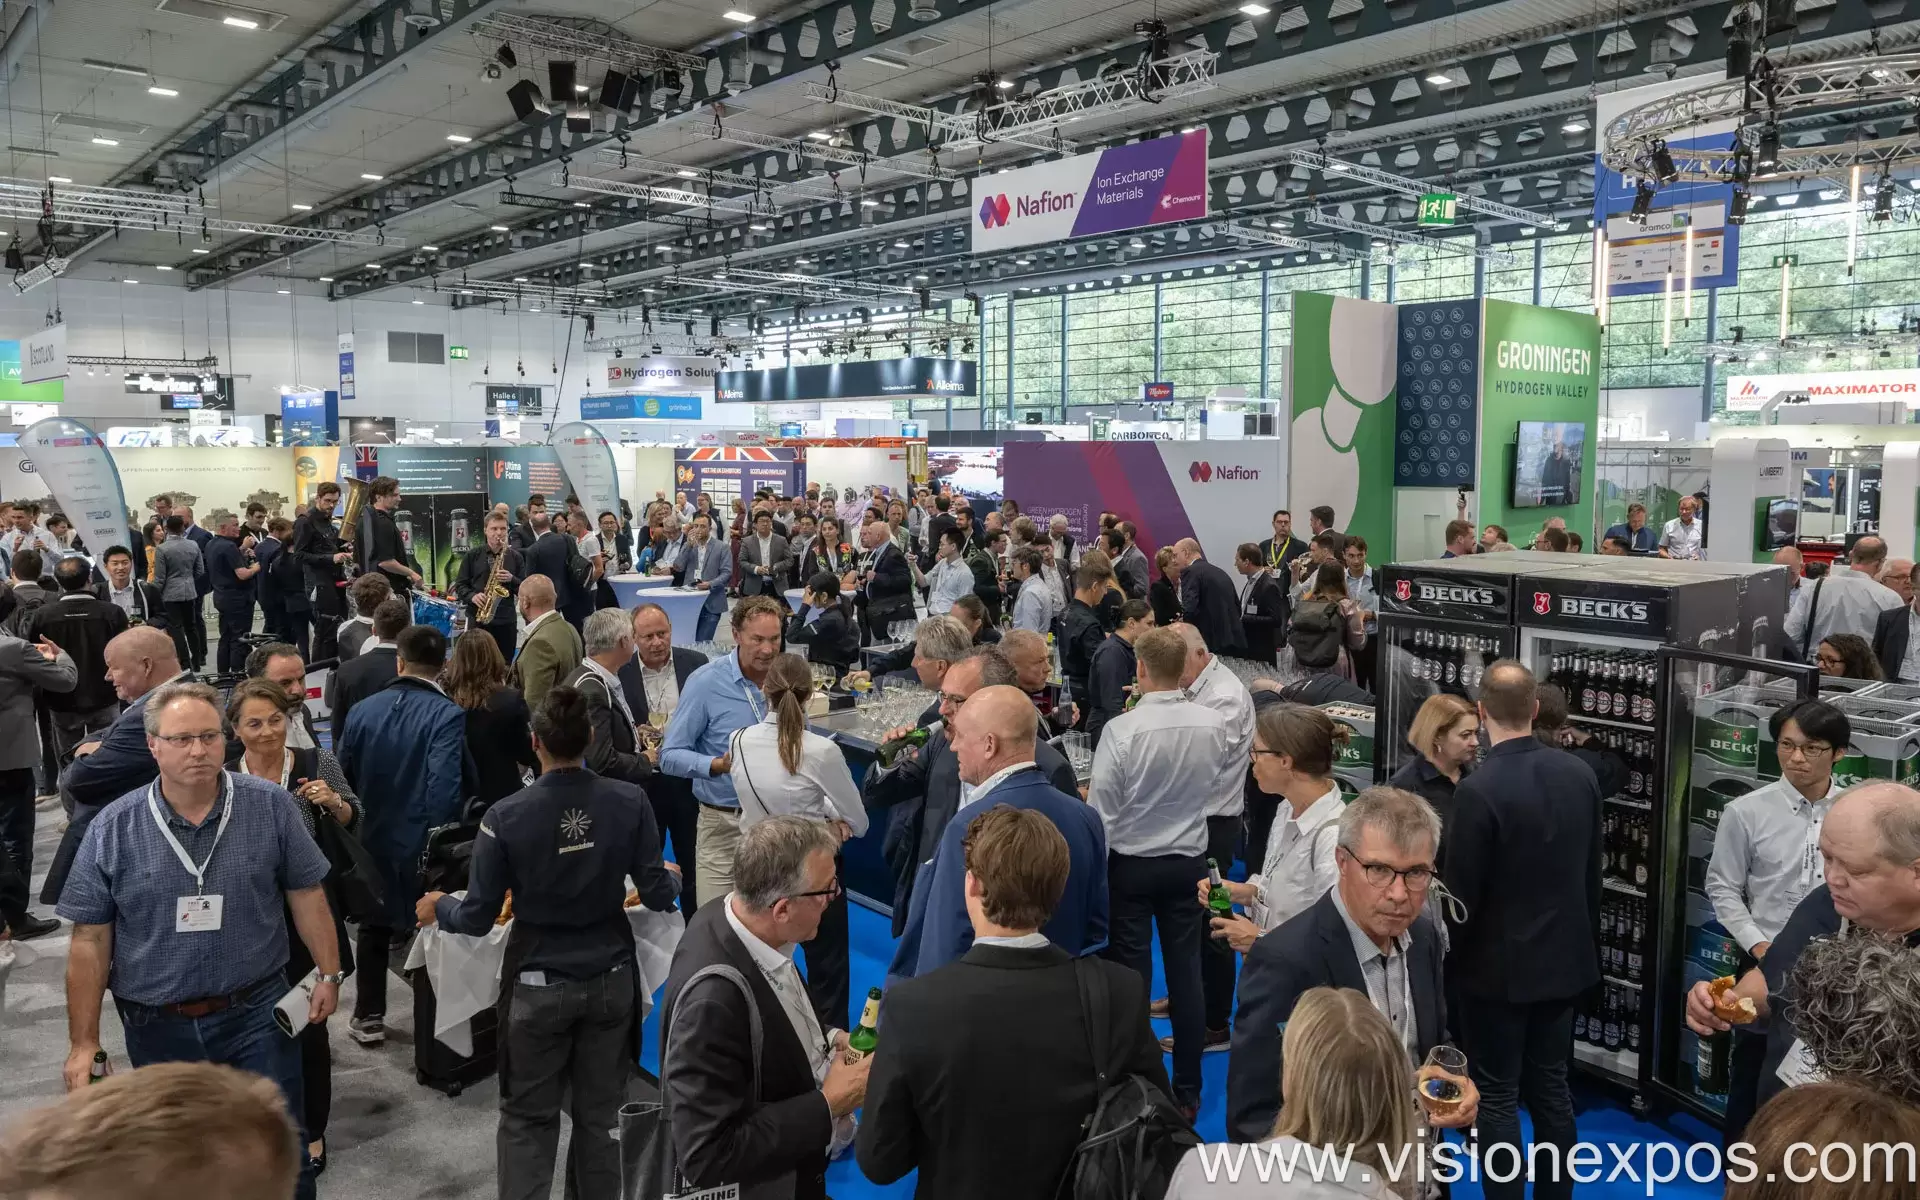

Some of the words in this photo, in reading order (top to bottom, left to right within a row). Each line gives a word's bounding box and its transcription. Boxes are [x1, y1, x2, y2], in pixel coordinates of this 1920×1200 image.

[1096, 175, 1112, 189] Ion
[1113, 166, 1165, 187] Exchange
[1096, 187, 1145, 205] Materials
[1171, 194, 1202, 205] Chemours
[1015, 190, 1075, 218] Nafion
[1639, 223, 1671, 233] aramco
[1497, 340, 1591, 376] GRONINGEN
[623, 367, 682, 379] Hydrogen
[935, 380, 965, 391] Alleima
[1495, 380, 1553, 396] HYDROGEN
[1555, 384, 1589, 399] VALLEY
[1807, 383, 1917, 396] MAXIMATOR
[492, 392, 511, 400] Halle
[511, 392, 517, 400] 6
[723, 389, 744, 399] Alleima
[1216, 465, 1259, 480] Nafion
[1026, 506, 1048, 514] GREEN
[1047, 507, 1082, 516] HYDROGEN
[1419, 584, 1495, 604] BECK'S
[1561, 598, 1648, 620] BECK'S
